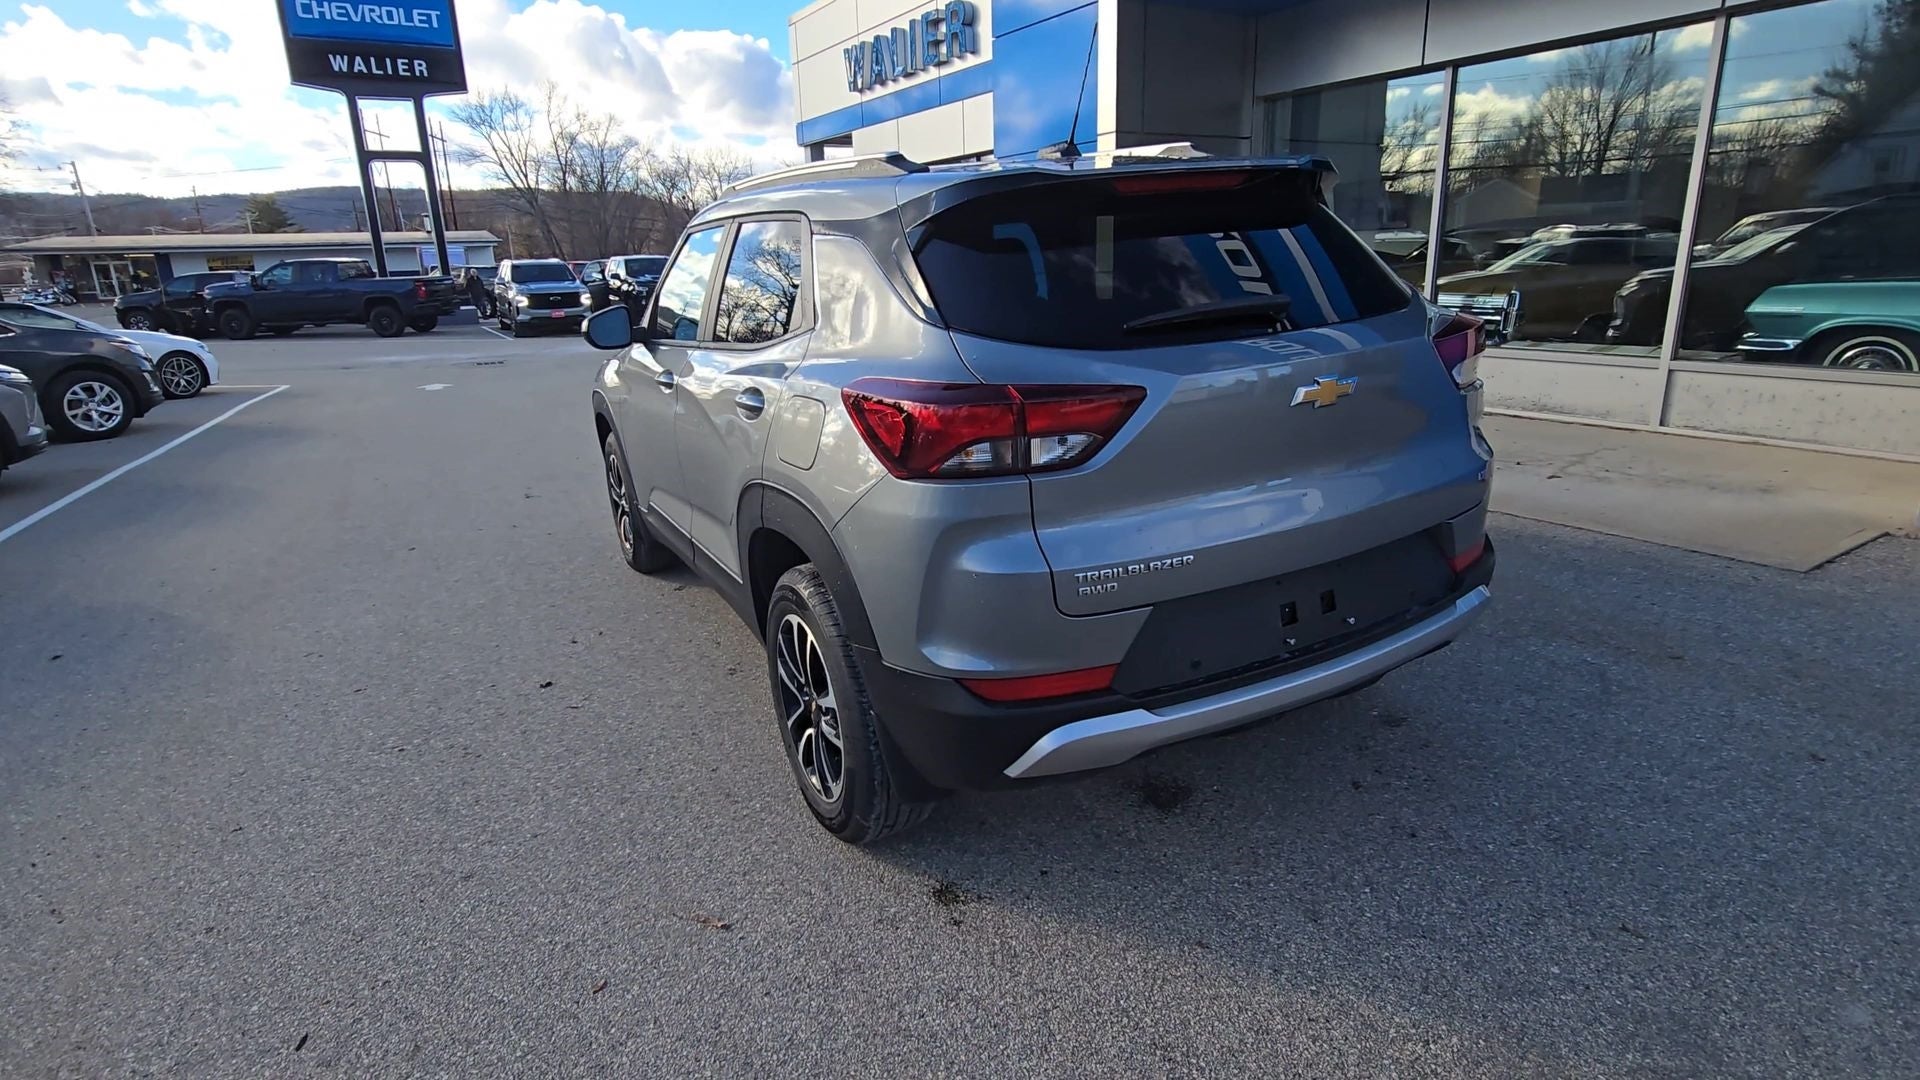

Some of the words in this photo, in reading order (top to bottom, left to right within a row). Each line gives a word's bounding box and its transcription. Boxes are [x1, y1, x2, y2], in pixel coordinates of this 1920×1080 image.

[295, 0, 440, 28] CHEVROLET
[843, 0, 977, 93] WALIER
[328, 54, 428, 77] WALIER
[1075, 554, 1195, 584] TRAILBLAZER
[1078, 582, 1119, 597] AWD
